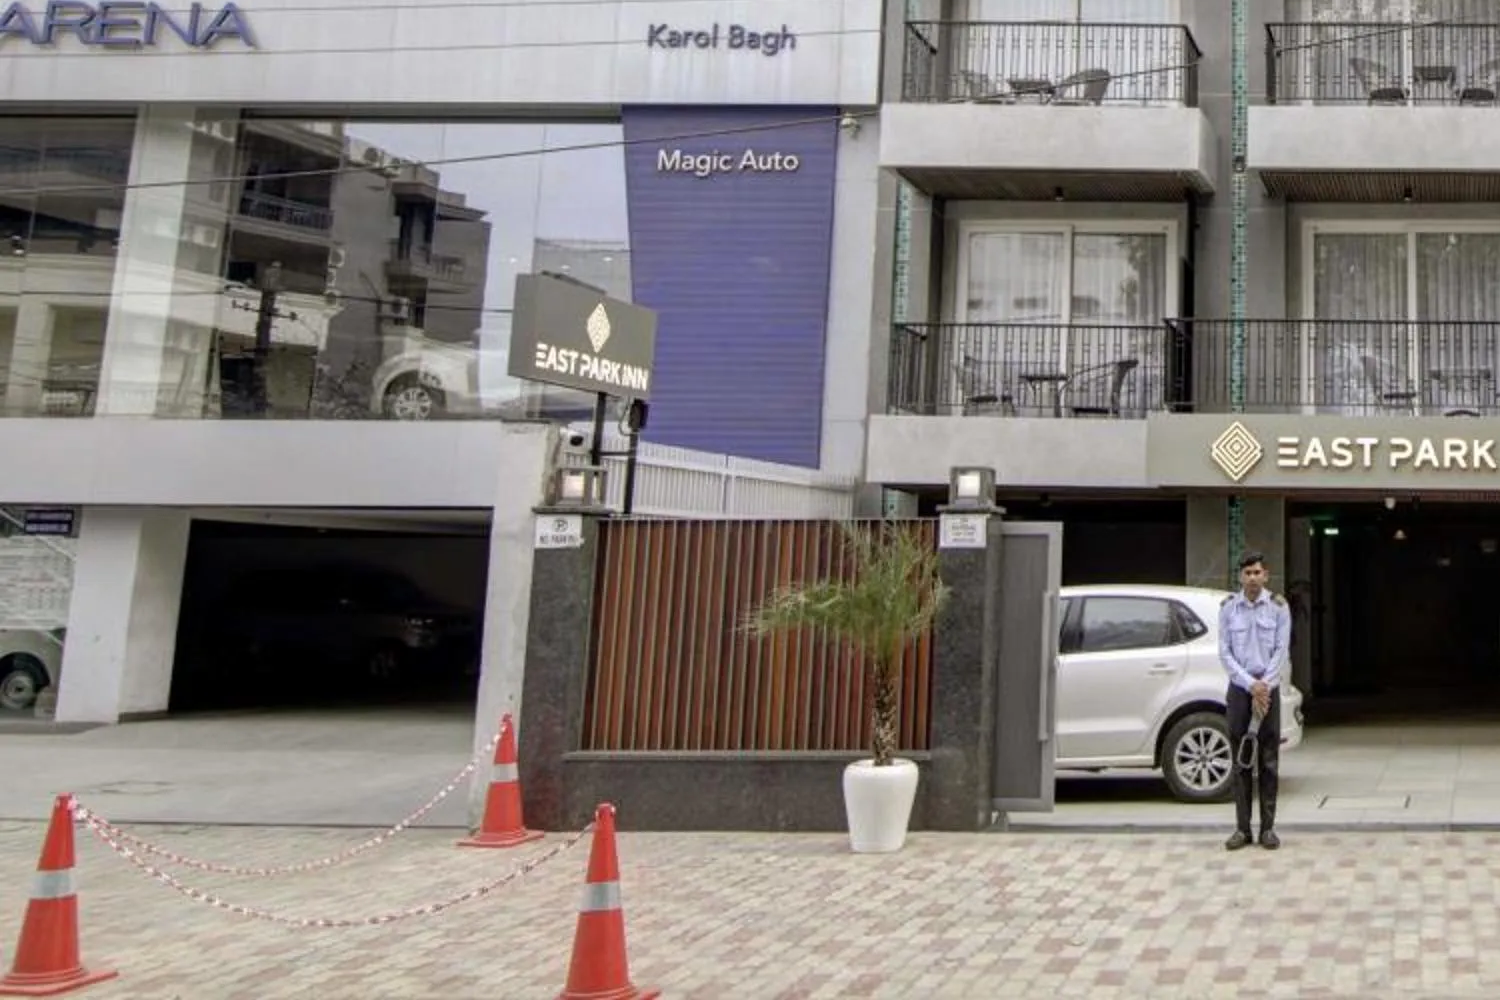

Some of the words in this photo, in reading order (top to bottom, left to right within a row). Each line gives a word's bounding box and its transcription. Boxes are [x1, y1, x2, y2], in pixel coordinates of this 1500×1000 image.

[0, 0, 258, 47] ARENA
[647, 22, 719, 49] Karol
[728, 23, 797, 57] Bagh
[657, 148, 733, 177] Magic
[739, 148, 799, 171] Auto
[535, 342, 579, 375] EAST
[579, 353, 621, 386] PARK
[1277, 436, 1379, 467] EAST
[1389, 437, 1497, 469] PARK
